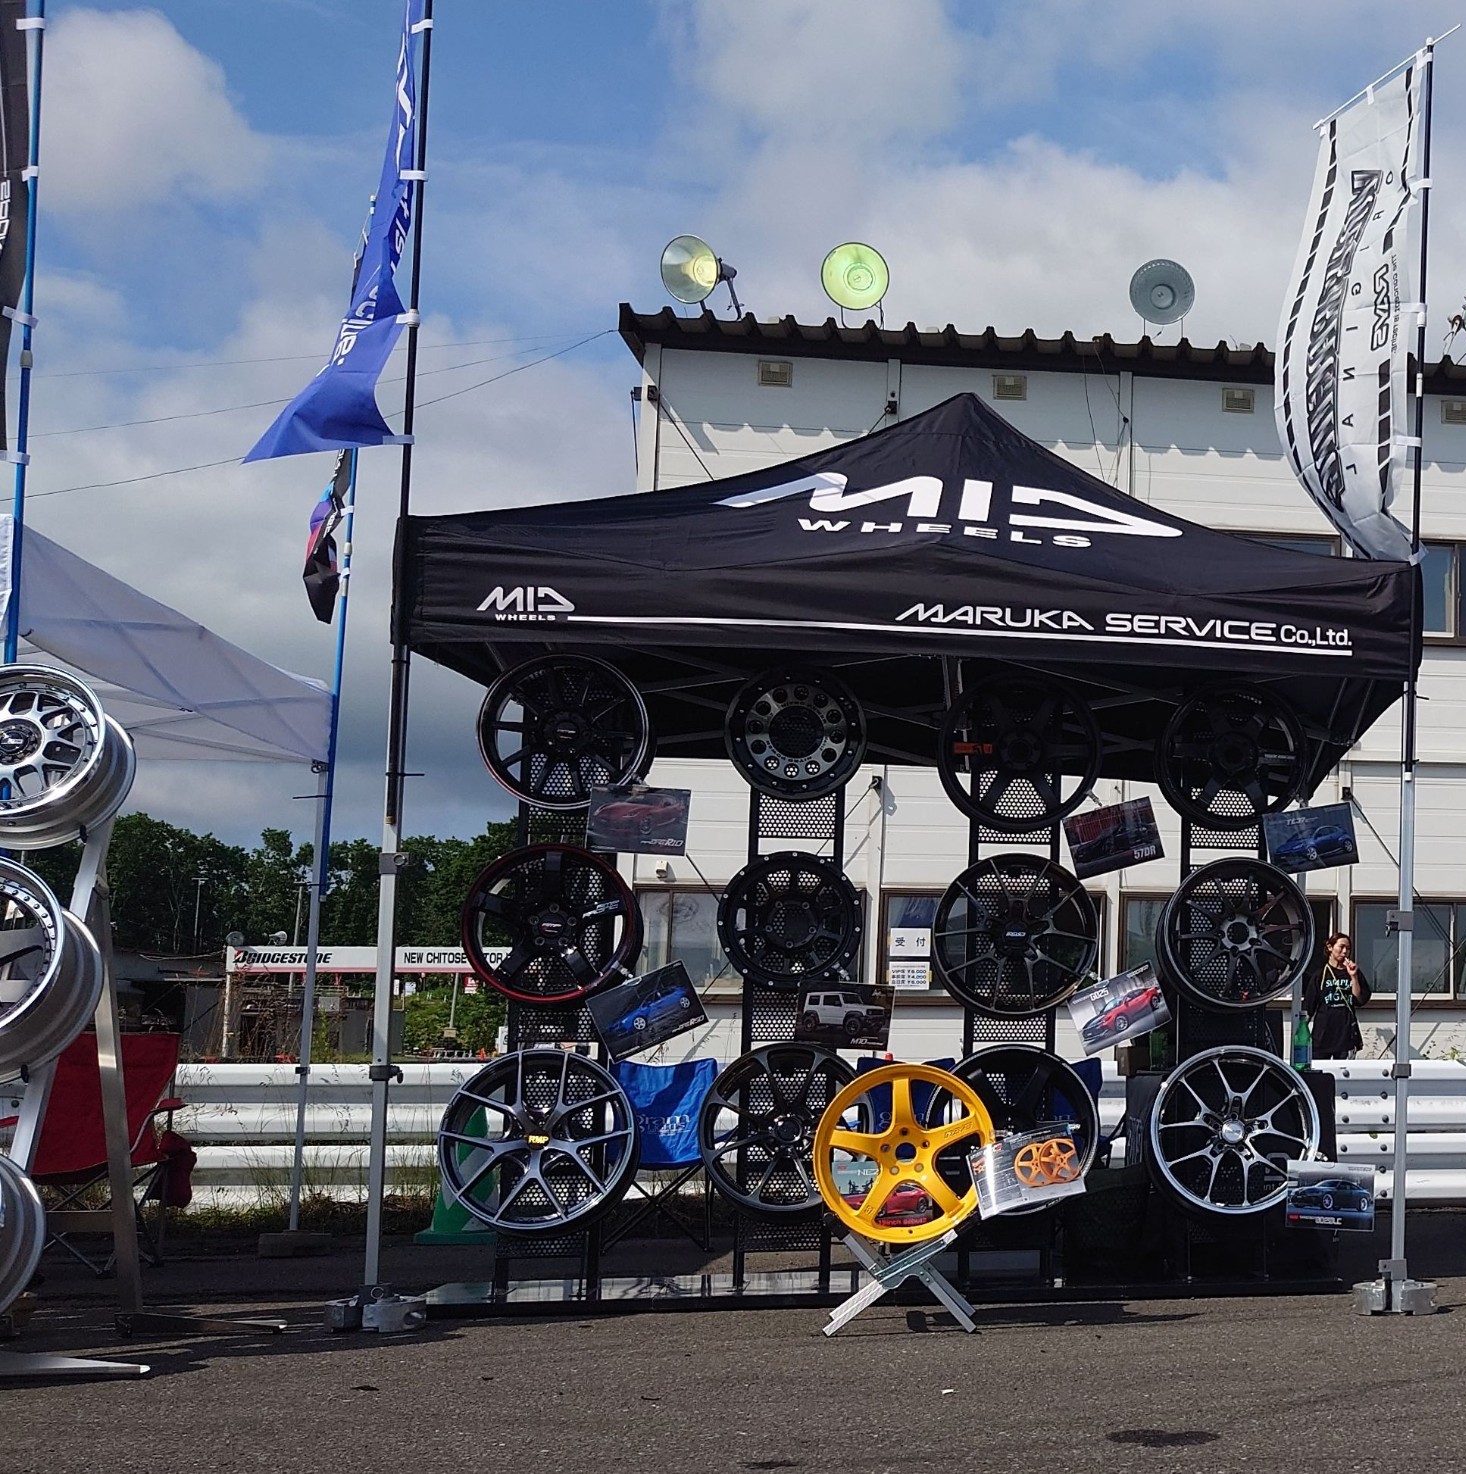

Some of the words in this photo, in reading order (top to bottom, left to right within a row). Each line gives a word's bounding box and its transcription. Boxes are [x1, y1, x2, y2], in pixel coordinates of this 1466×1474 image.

[711, 472, 1183, 538] MID
[797, 518, 1092, 548] WHEELS
[476, 586, 575, 614] MID
[495, 613, 556, 622] WHEELS
[895, 602, 1094, 631] MARUKA
[1105, 613, 1277, 642] SERVICE
[1280, 624, 1353, 648] Co.,Ltd.
[895, 936, 926, 947] 受付
[232, 950, 332, 965] BRIDGESTNE
[404, 952, 423, 964] NEW
[426, 952, 467, 964] CHITOSE
